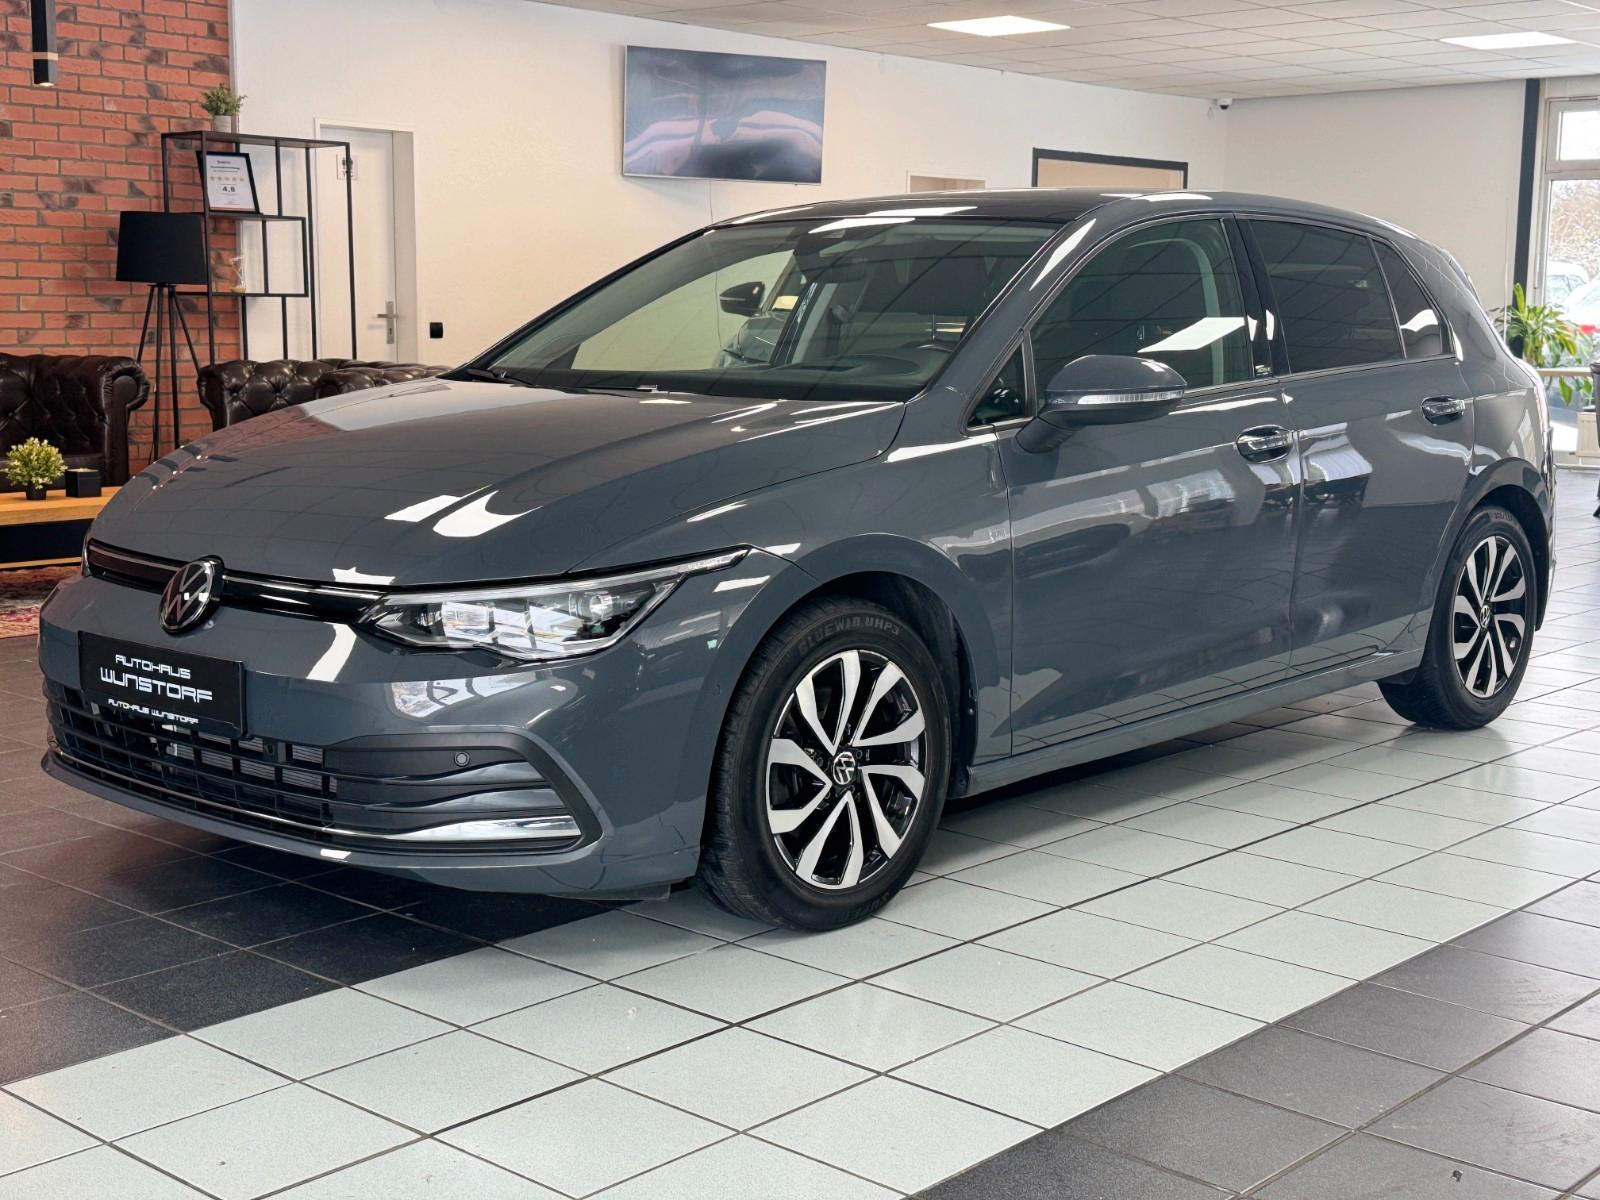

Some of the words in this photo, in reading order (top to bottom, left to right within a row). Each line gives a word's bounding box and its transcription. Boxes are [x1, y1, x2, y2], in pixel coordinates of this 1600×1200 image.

[115, 654, 191, 680] AUTOHAUS
[100, 667, 213, 703] WUNSTORF
[108, 698, 150, 715] AUTOHAUS
[151, 708, 199, 725] WUNSTORF
